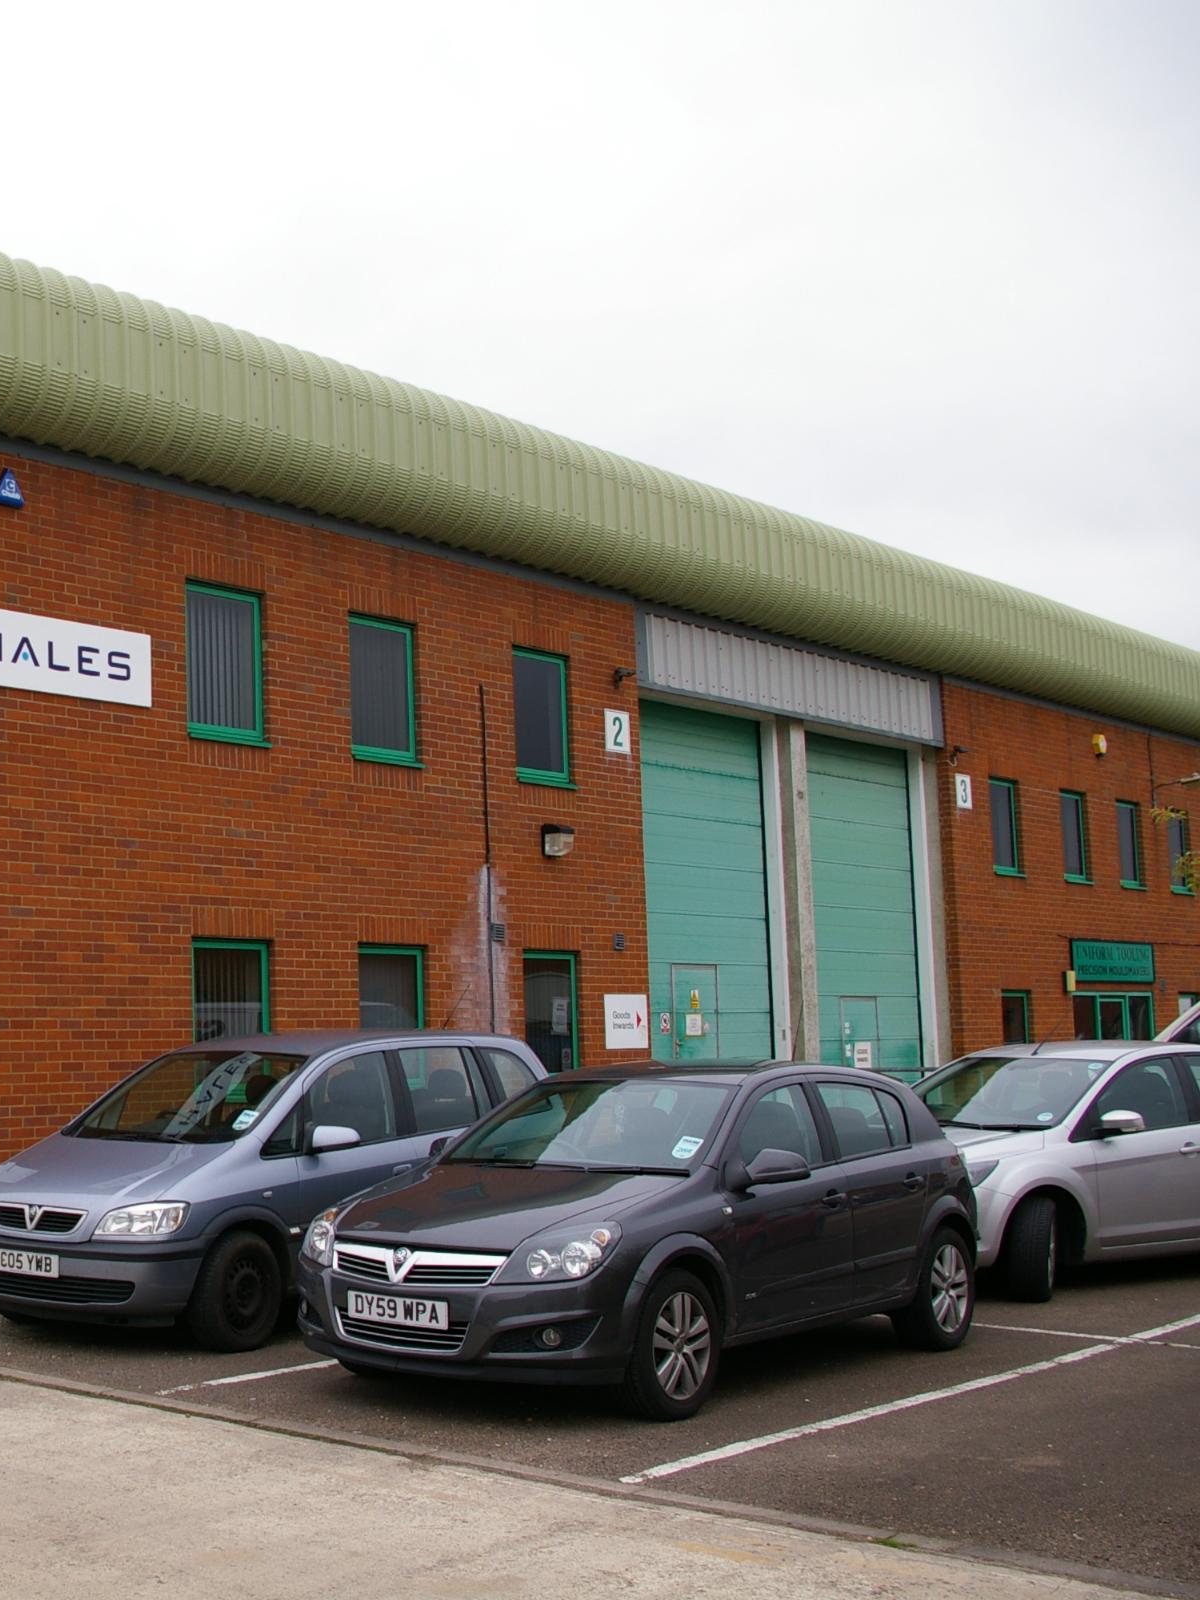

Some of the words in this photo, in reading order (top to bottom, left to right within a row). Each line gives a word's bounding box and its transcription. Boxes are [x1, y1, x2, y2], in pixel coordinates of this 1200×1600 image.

[613, 716, 623, 747] 2
[960, 779, 968, 804] 3
[612, 1010, 631, 1020] Goods
[27, 1254, 52, 1273] YWB
[354, 1294, 397, 1319] DY59
[403, 1300, 439, 1324] WPA
